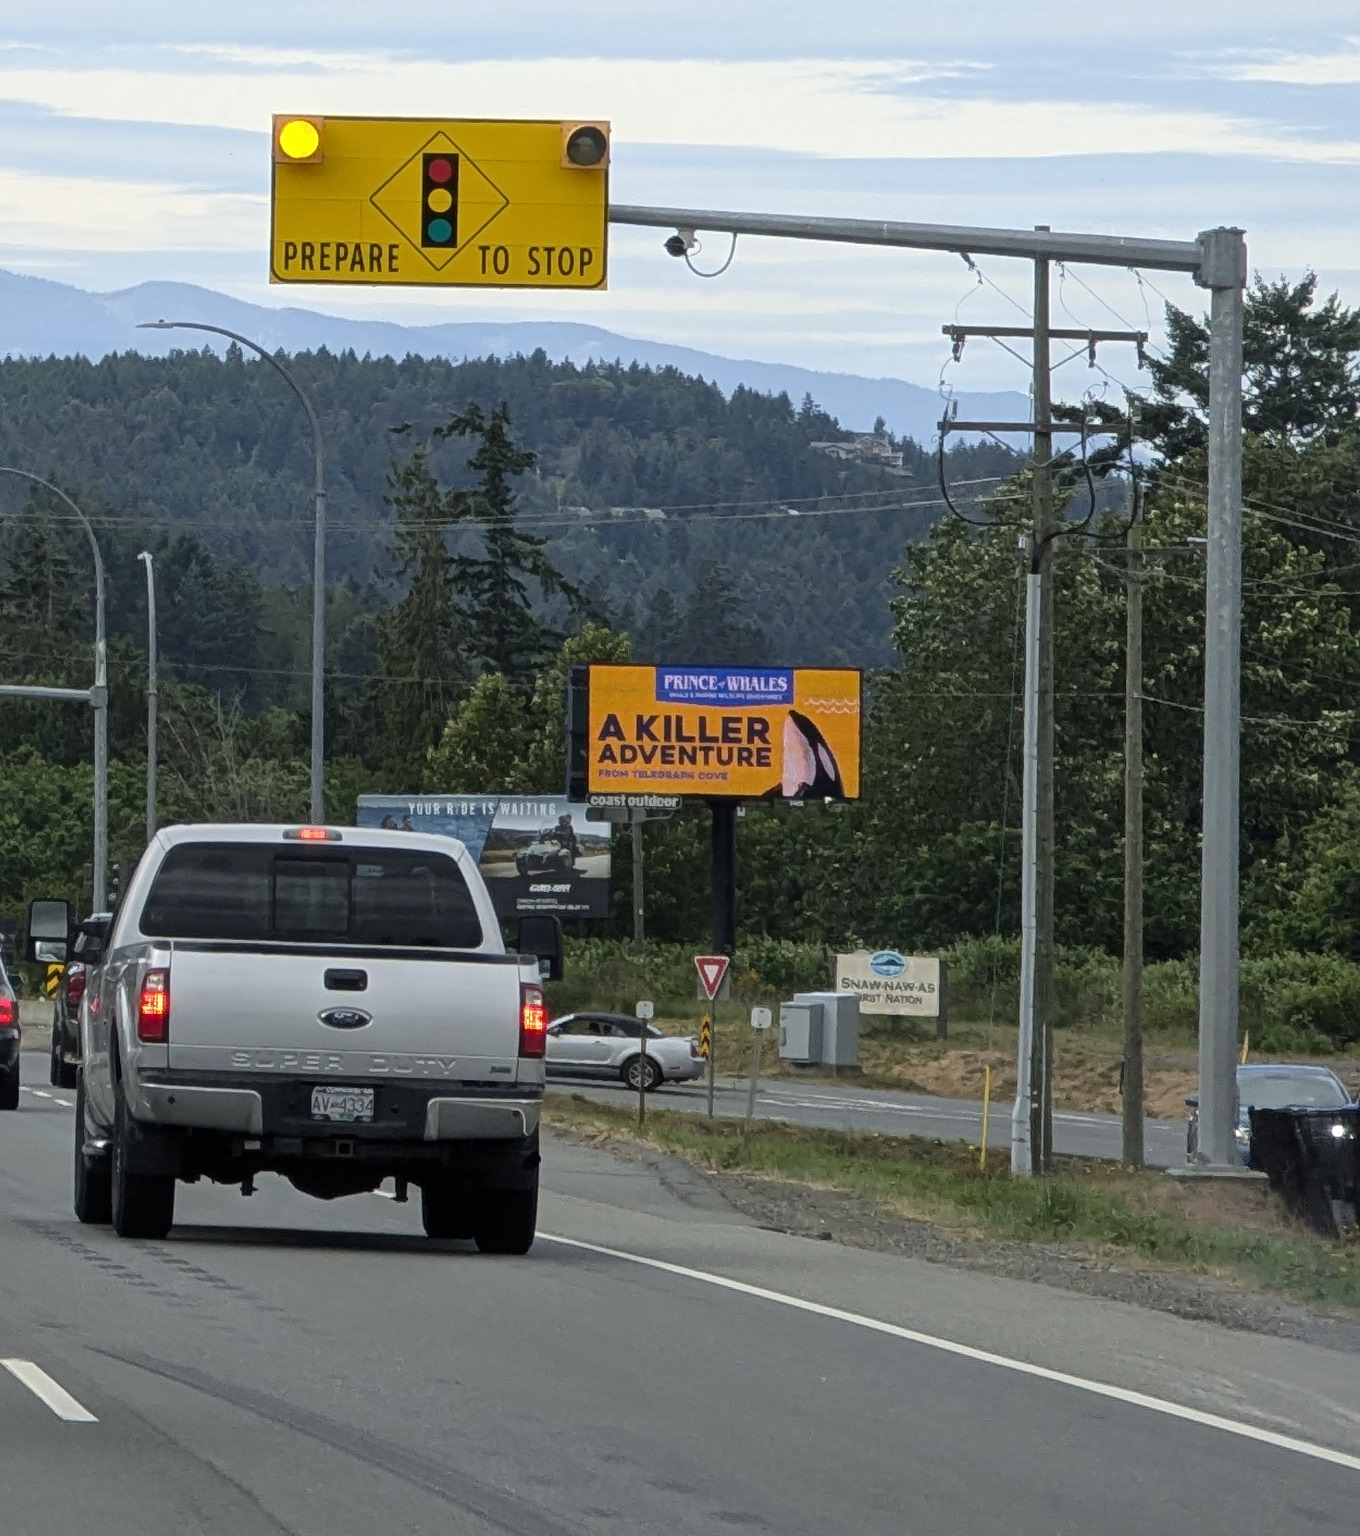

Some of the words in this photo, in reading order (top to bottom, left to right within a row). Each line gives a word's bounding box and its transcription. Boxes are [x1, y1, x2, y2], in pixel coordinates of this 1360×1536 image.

[283, 241, 400, 273] PREPARE
[478, 245, 510, 275] TO
[527, 247, 594, 276] STOP
[664, 674, 718, 690] PRINCE
[726, 675, 788, 692] WHALES
[597, 713, 626, 742] A
[635, 714, 771, 745] KILLER
[597, 744, 773, 768] ADVENTURE
[598, 768, 629, 778] FROM
[408, 802, 440, 815] YOUR
[446, 802, 475, 816] RIDE
[482, 802, 495, 816] IS
[500, 802, 556, 816] WAITING
[590, 794, 626, 806] coast
[628, 795, 680, 808] outdoor
[231, 1051, 344, 1071] SUPER
[369, 1054, 457, 1075] DUTY
